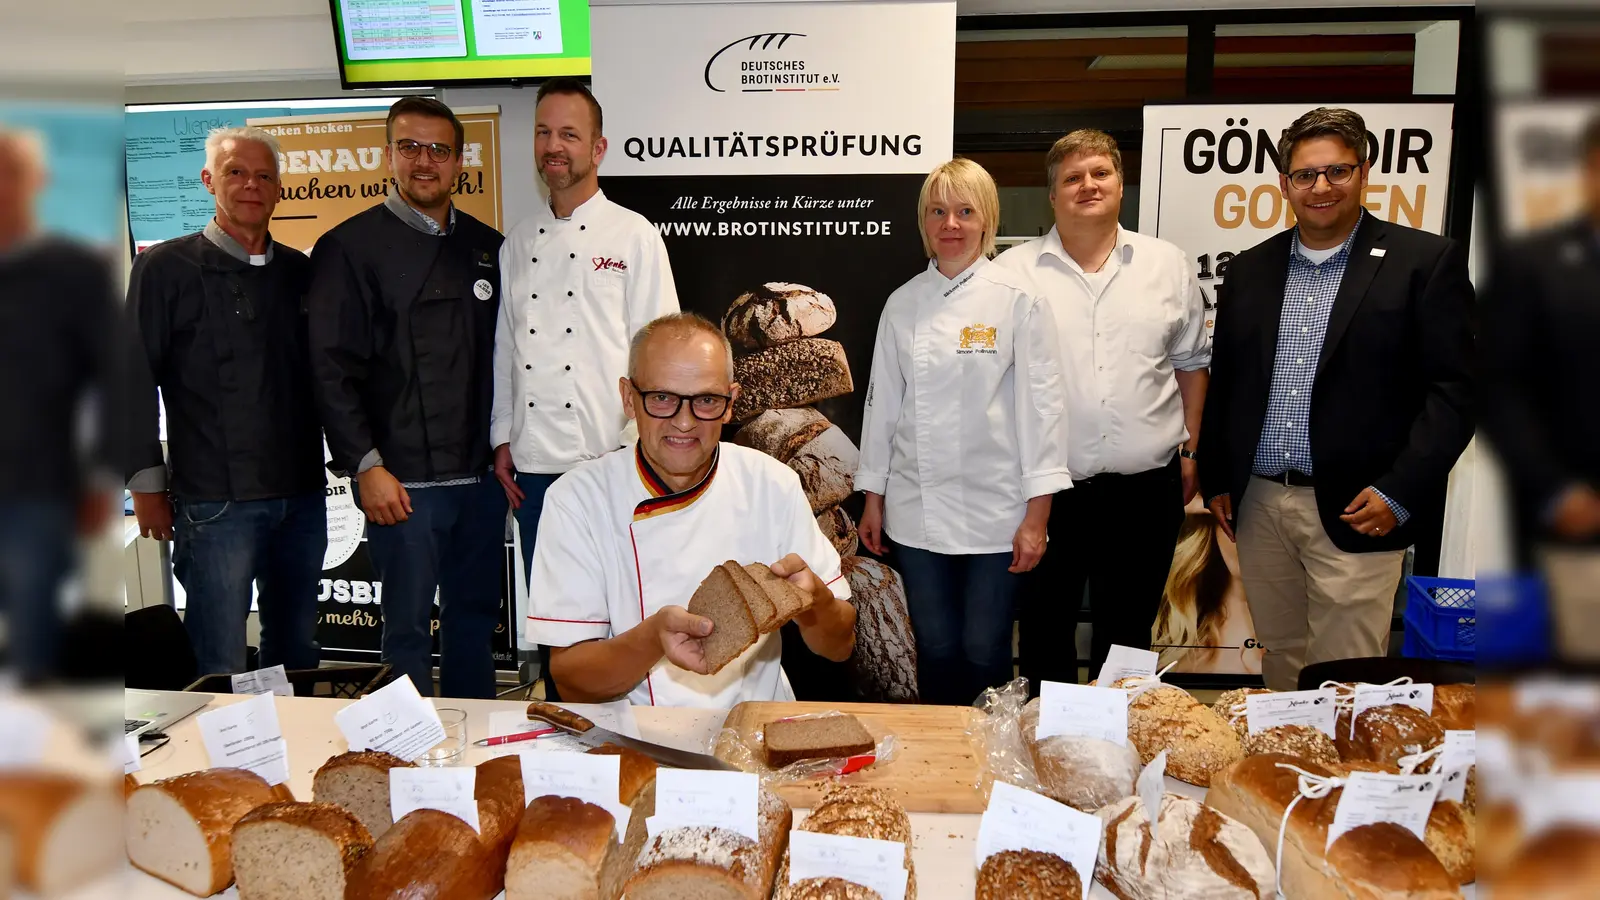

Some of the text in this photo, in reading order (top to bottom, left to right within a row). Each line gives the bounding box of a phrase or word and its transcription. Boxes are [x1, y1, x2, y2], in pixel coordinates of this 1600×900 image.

[741, 60, 805, 71] DEUTSCHES
[741, 73, 840, 84] BROTINSTITUT e.V.
[305, 122, 353, 134] backen
[624, 131, 922, 162] QUALITÄTSPRÜFUNG
[1183, 118, 1290, 174] GÖN
[670, 195, 874, 214] Alle Ergebnisse in Kürze unter
[654, 221, 892, 236] WWW.BROTINSTITUT.DE
[326, 609, 377, 628] mehr
